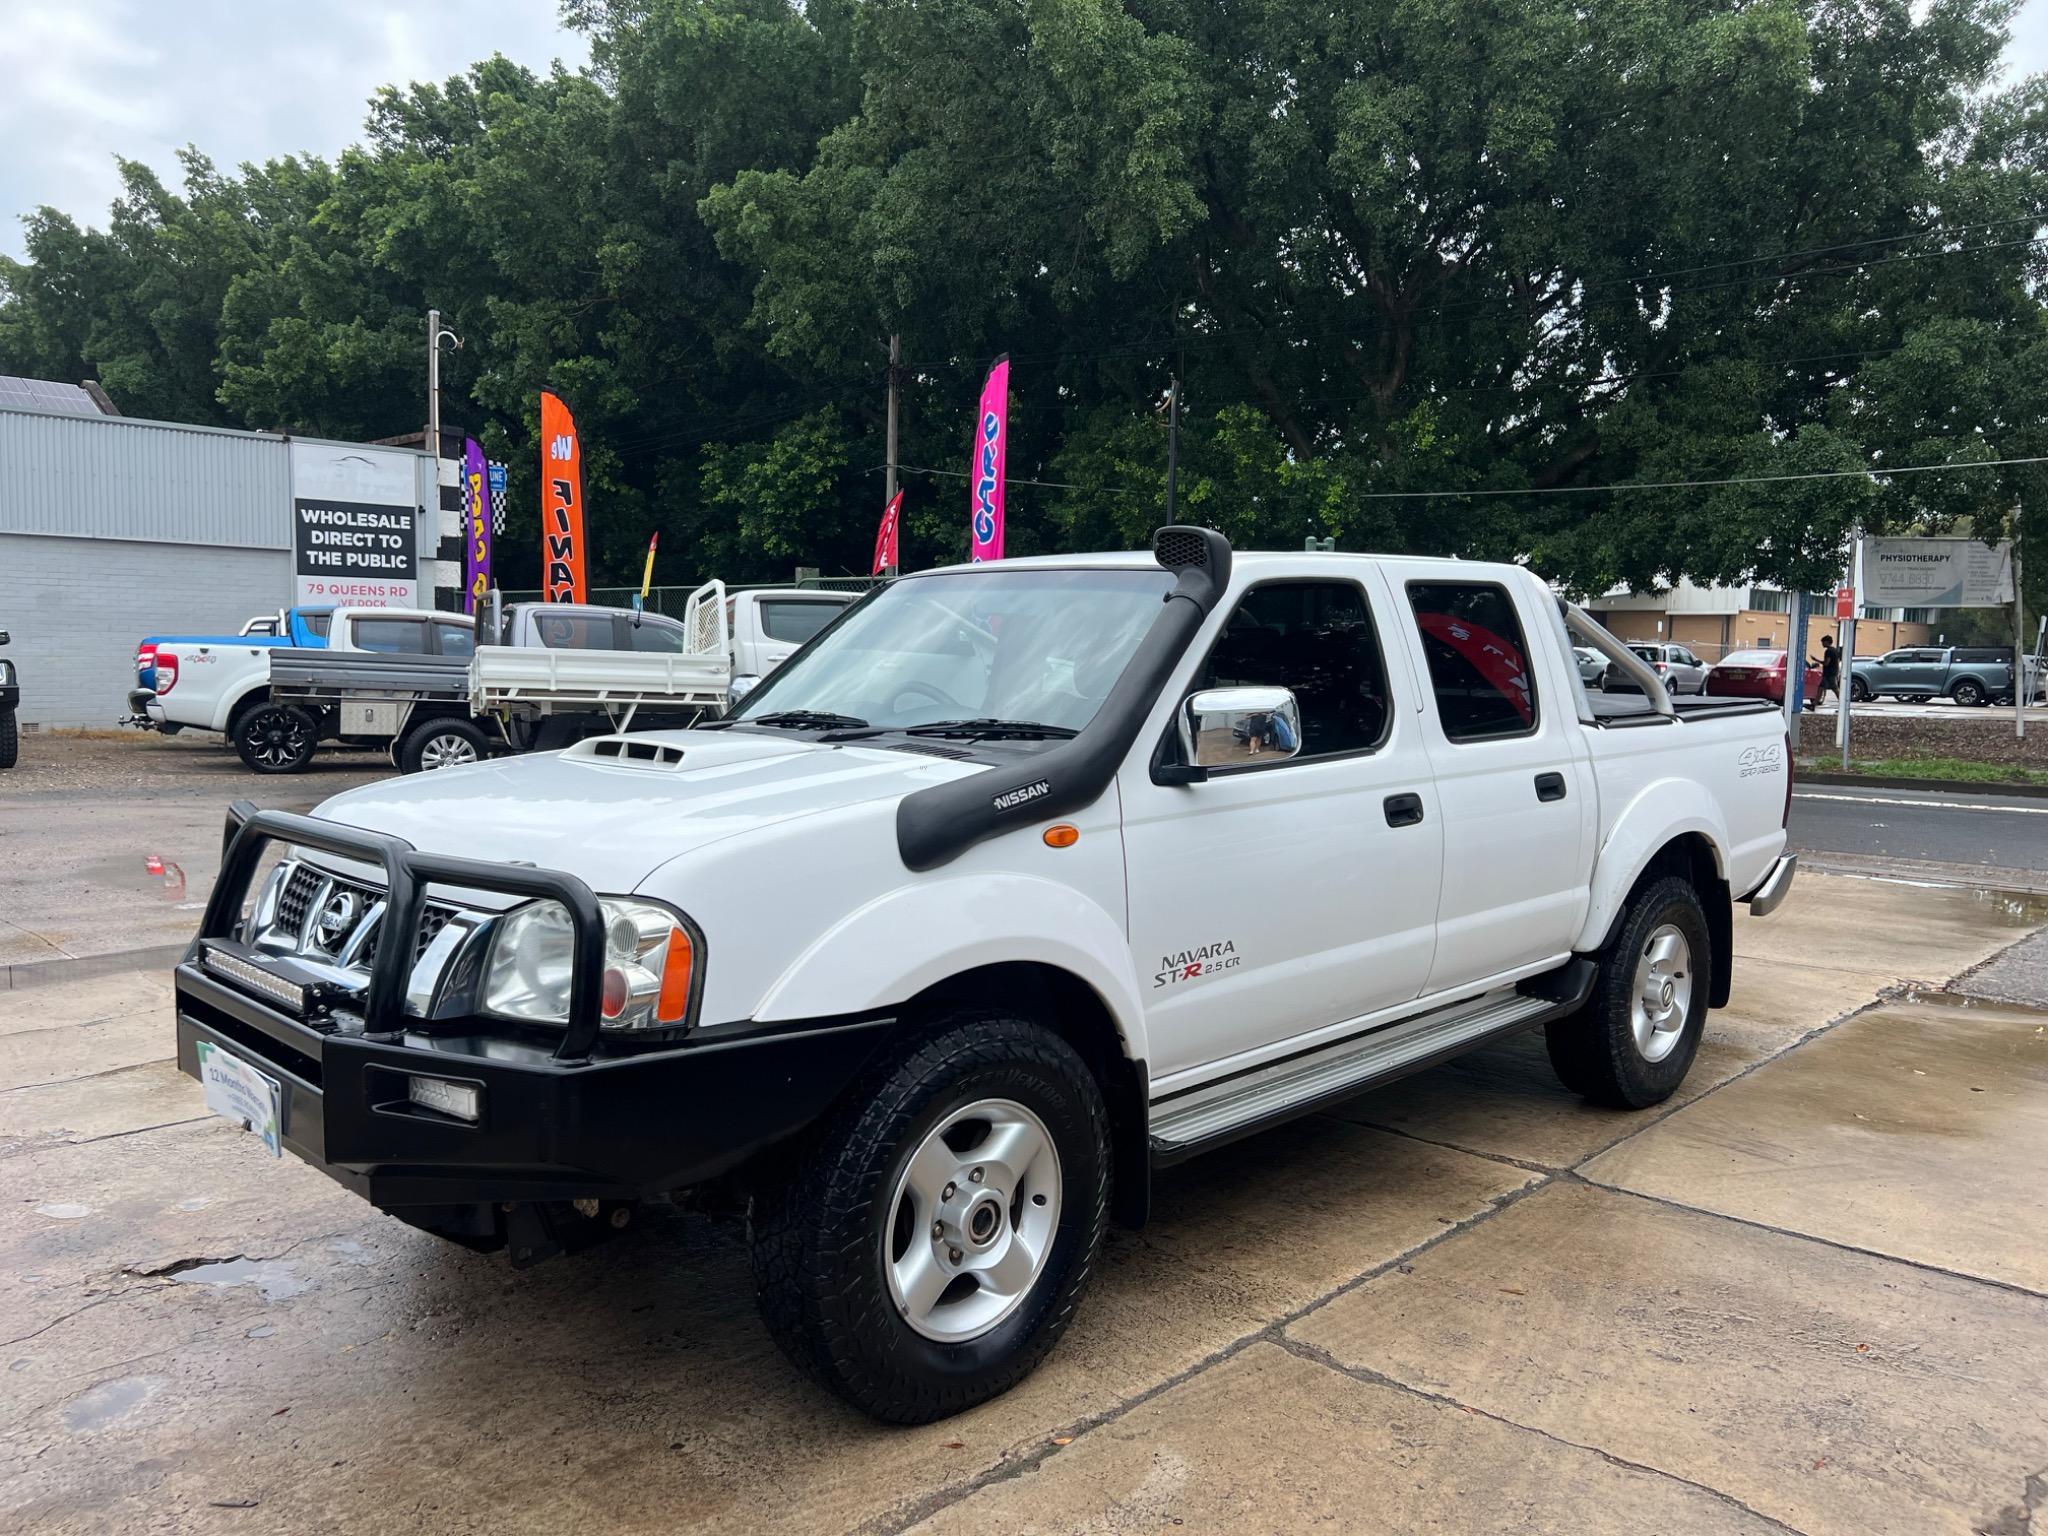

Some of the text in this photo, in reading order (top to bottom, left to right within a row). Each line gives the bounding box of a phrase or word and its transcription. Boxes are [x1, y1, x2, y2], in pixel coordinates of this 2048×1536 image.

[300, 509, 411, 530] WHOLESALE
[311, 530, 402, 549] DIRECT TO
[306, 551, 408, 569] THE PUBLIC
[1880, 554, 1951, 563] PHYSIOTHERAPY
[308, 583, 408, 597] 79 QUEENS RD
[996, 781, 1048, 810] NISSAN
[1161, 940, 1235, 971] NAVARA
[1153, 956, 1241, 989] ST-R 2.5 CR
